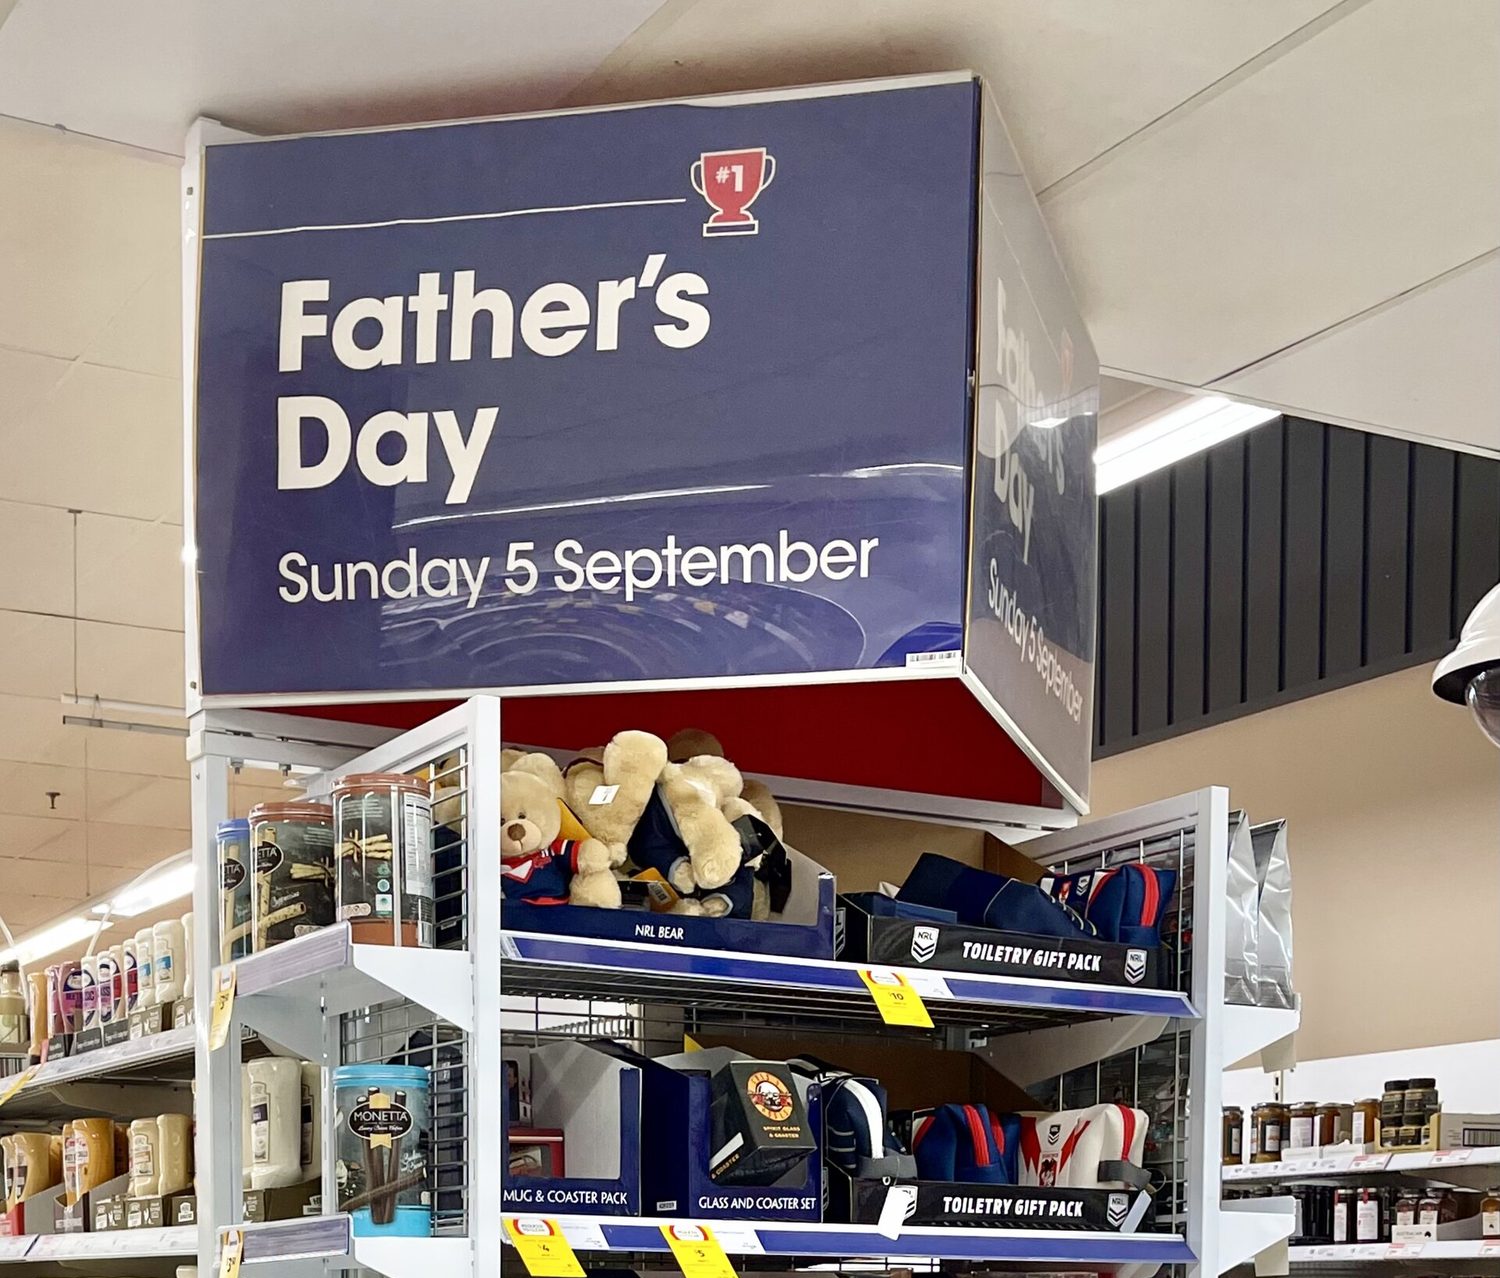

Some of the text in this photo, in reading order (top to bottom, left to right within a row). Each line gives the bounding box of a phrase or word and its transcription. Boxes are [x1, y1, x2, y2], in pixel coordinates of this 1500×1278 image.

[714, 163, 746, 193] #1
[278, 253, 712, 373] Father's
[276, 393, 500, 505] Day
[277, 528, 880, 609] Sunday 5 September
[988, 557, 1032, 663] Sunday
[635, 924, 684, 940] NRL BEAR
[962, 941, 1102, 972] TOILETRY GIFT PACK
[354, 1110, 408, 1122] MONETTA
[503, 1190, 627, 1205] MUG & COASTER PACK
[699, 1196, 816, 1210] GLASS AND COASTER SET
[943, 1197, 1083, 1218] TOILETRY GIFT PACK
